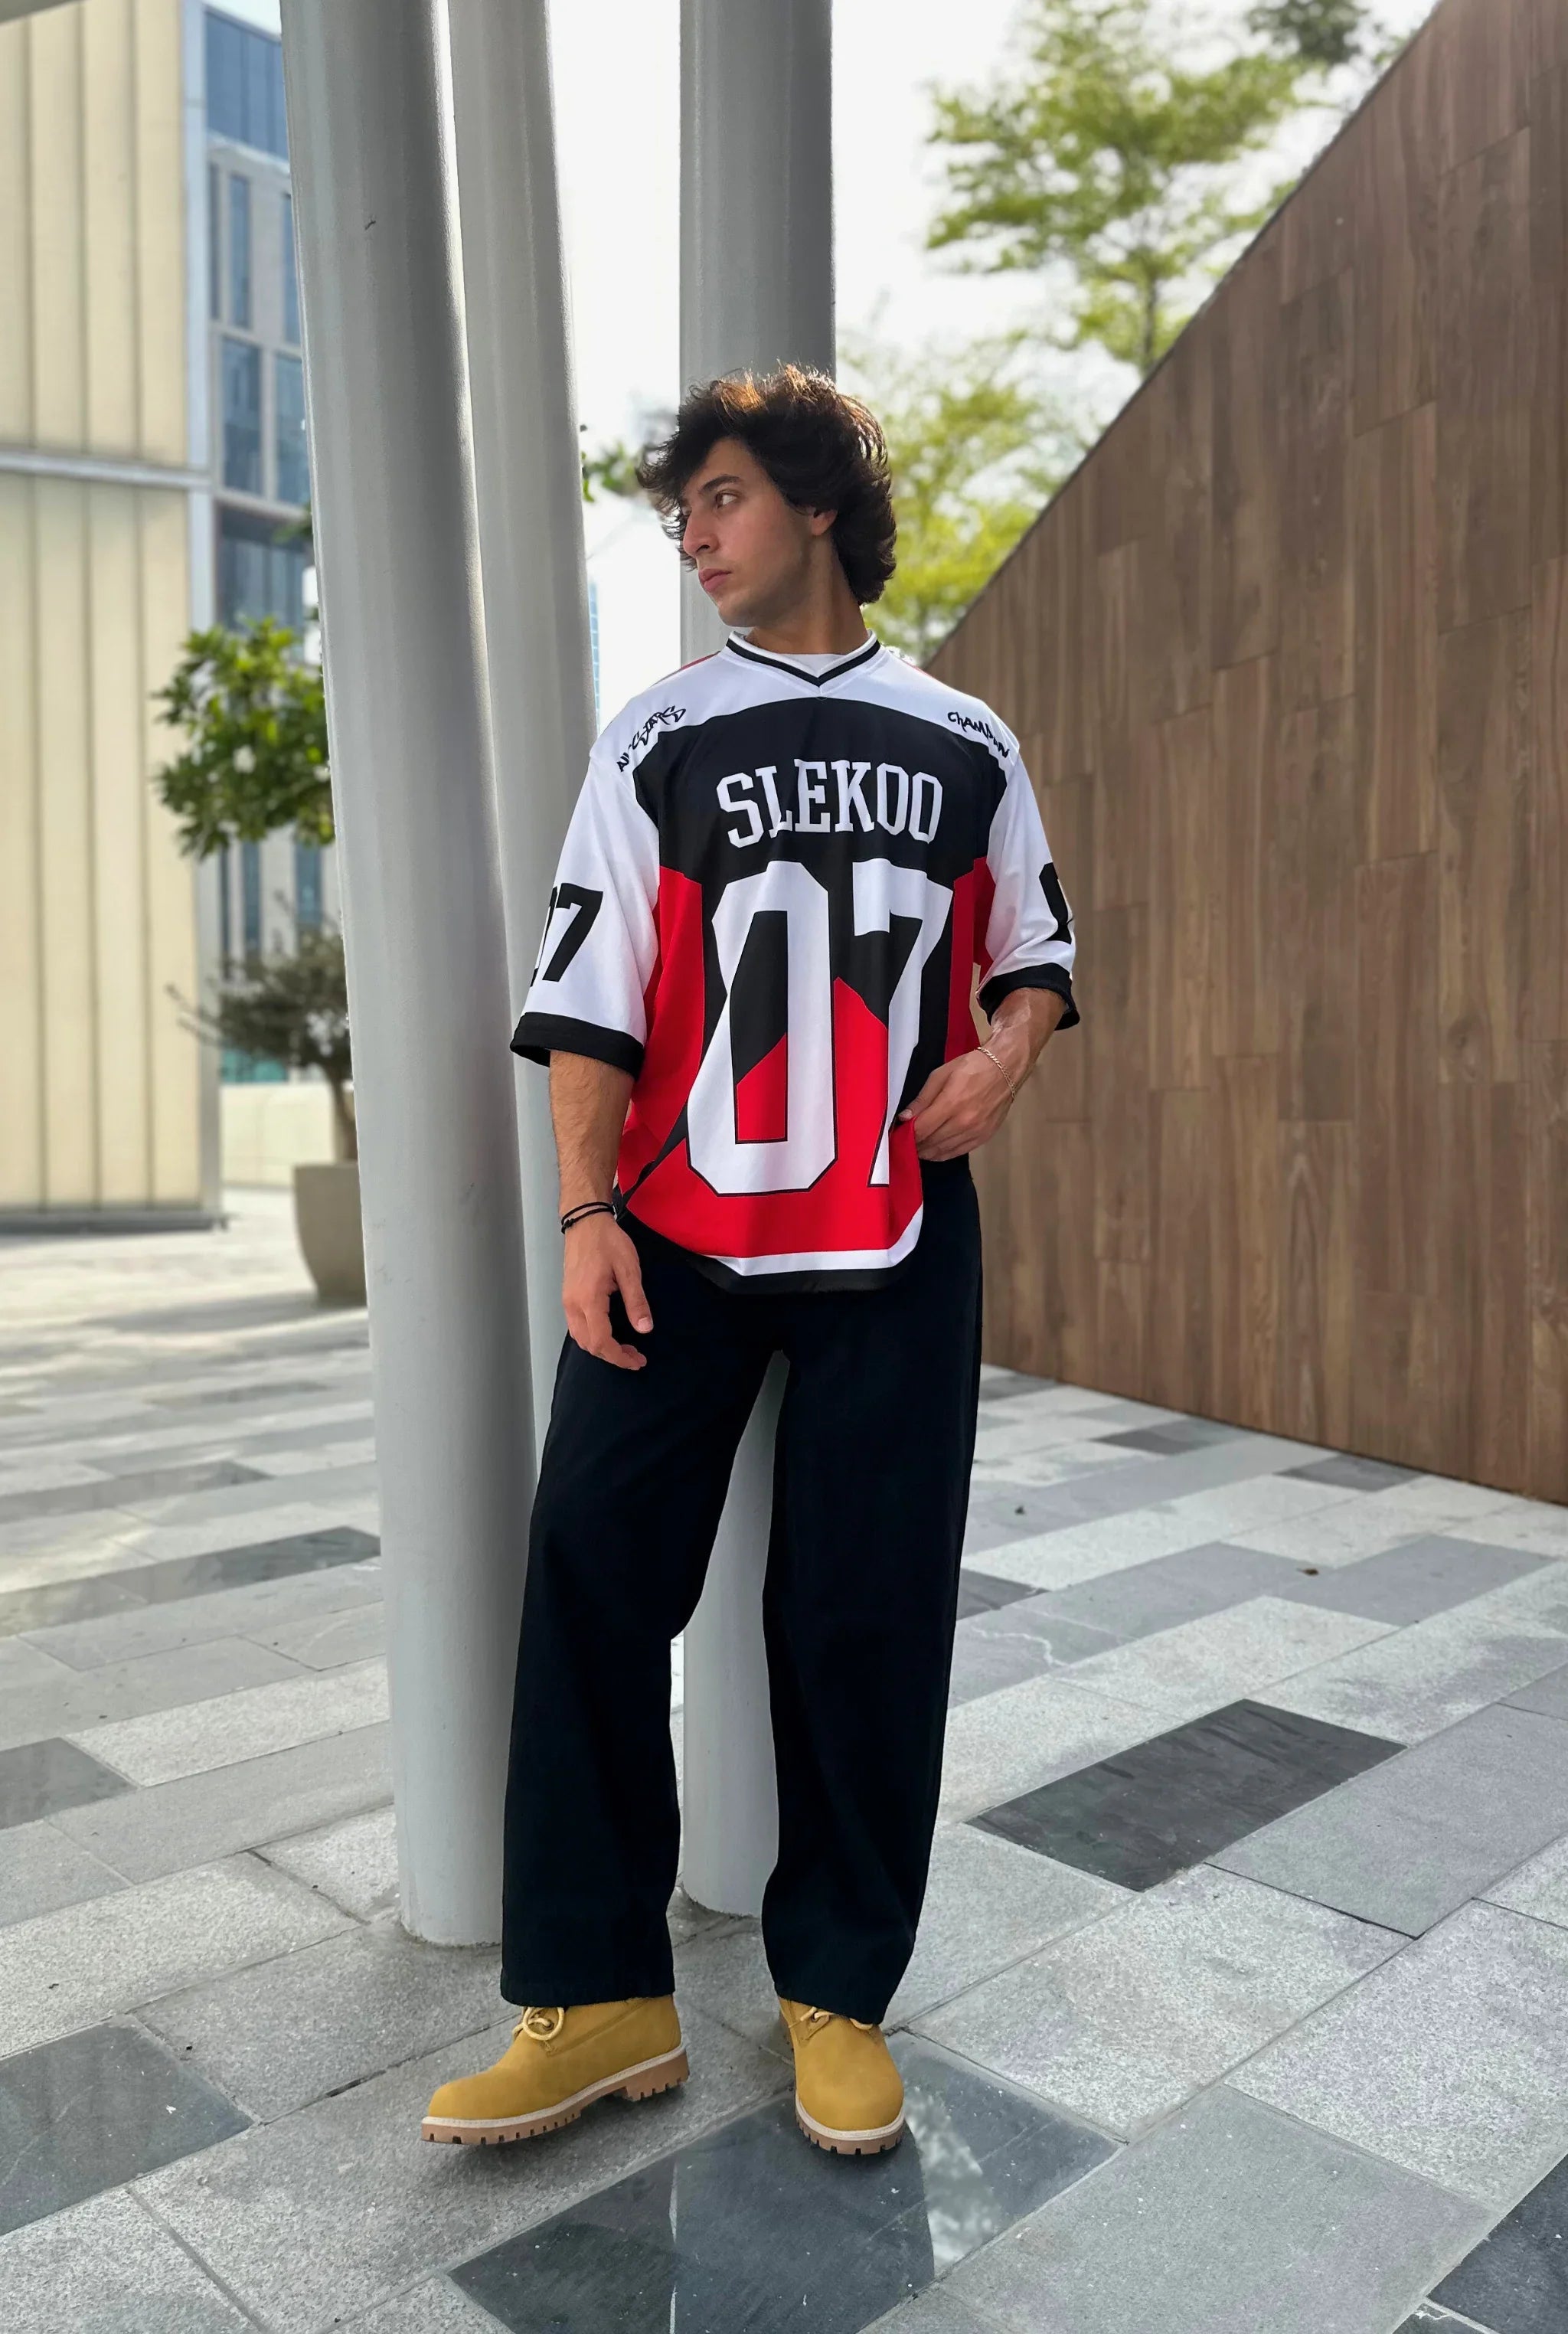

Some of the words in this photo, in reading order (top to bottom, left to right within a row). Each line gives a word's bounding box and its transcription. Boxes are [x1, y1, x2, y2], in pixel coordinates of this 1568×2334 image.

[717, 758, 943, 848] SLEKOO
[530, 882, 604, 987] 7
[687, 858, 955, 1195] 07
